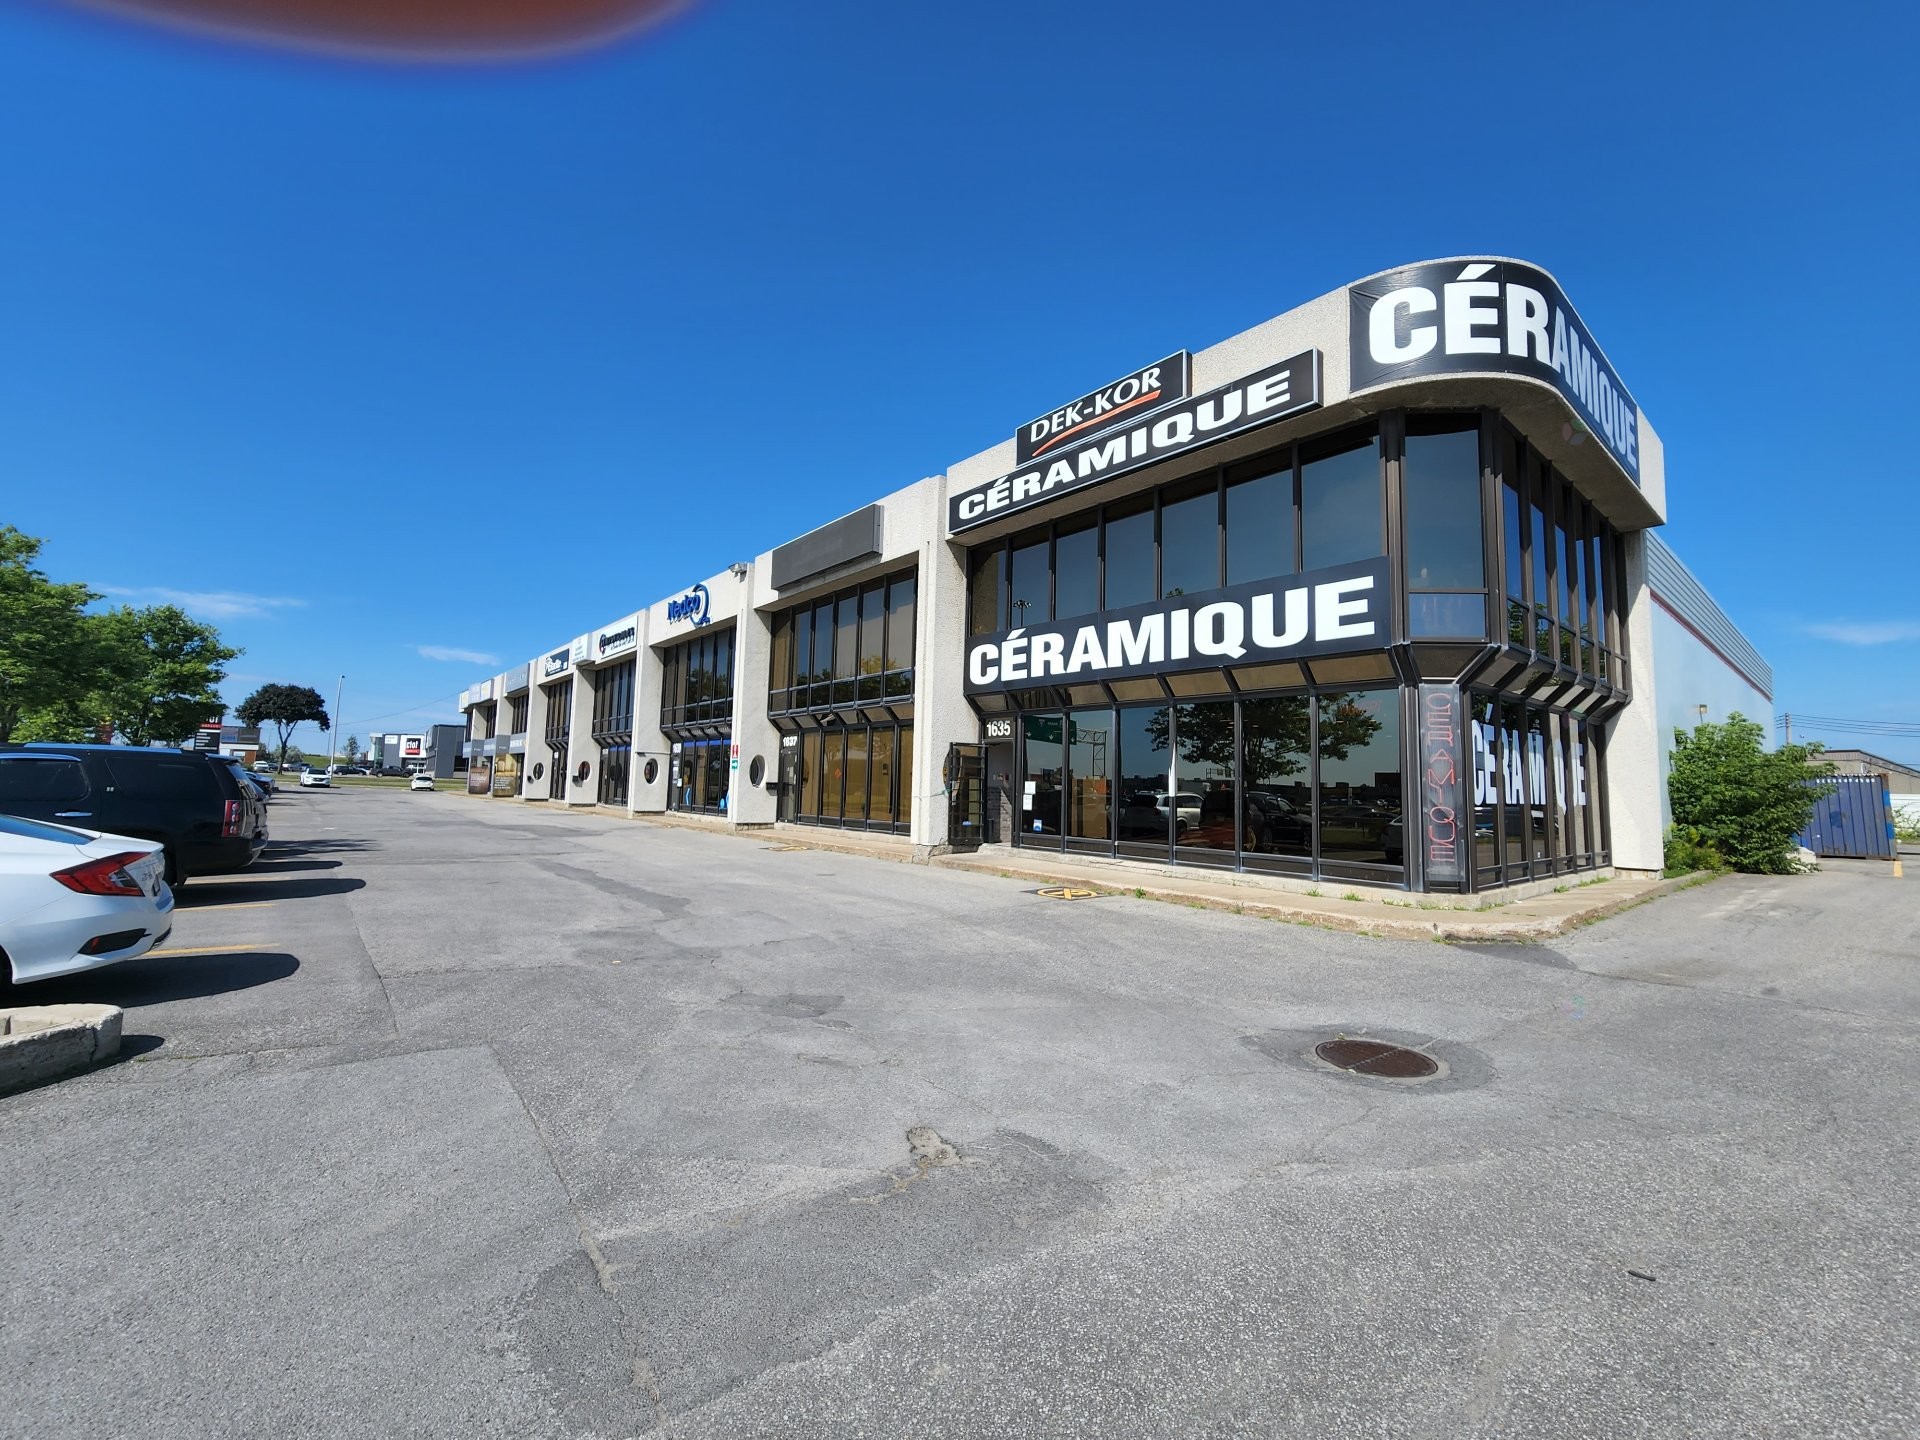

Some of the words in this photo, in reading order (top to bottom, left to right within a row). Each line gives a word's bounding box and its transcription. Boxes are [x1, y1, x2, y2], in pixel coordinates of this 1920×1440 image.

[1029, 366, 1162, 443] DEK-KOR
[1369, 263, 1638, 470] CÉRAMIQUE
[958, 369, 1291, 520] CÉRAMIQUE
[969, 575, 1375, 685] CÉRAMIQUE
[986, 720, 1011, 737] 1635
[1471, 702, 1587, 816] CÉRAMQE
